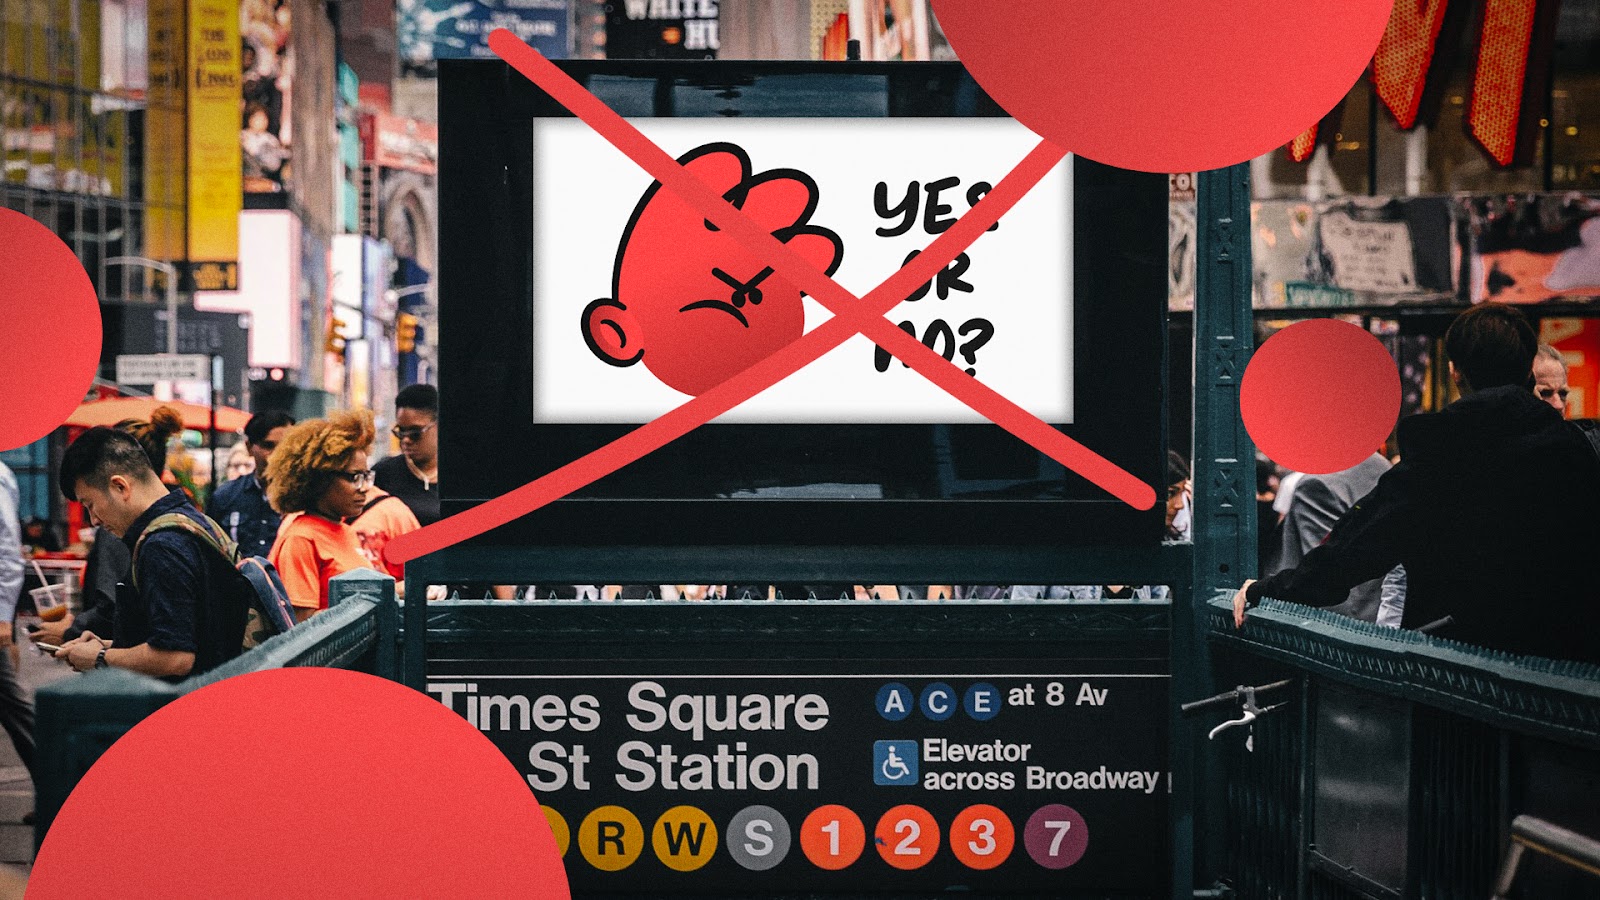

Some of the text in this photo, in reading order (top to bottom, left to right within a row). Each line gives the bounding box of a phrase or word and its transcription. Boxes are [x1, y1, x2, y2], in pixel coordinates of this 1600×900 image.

[874, 177, 999, 238] YES
[428, 681, 830, 741] Times Square
[884, 682, 1109, 713] A C E at 8 Av
[527, 741, 819, 792] St Station
[923, 738, 1032, 763] Elevator
[924, 771, 1016, 791] across
[1026, 765, 1160, 794] Broadway
[598, 818, 1071, 857] R W S 1 2 3 7
